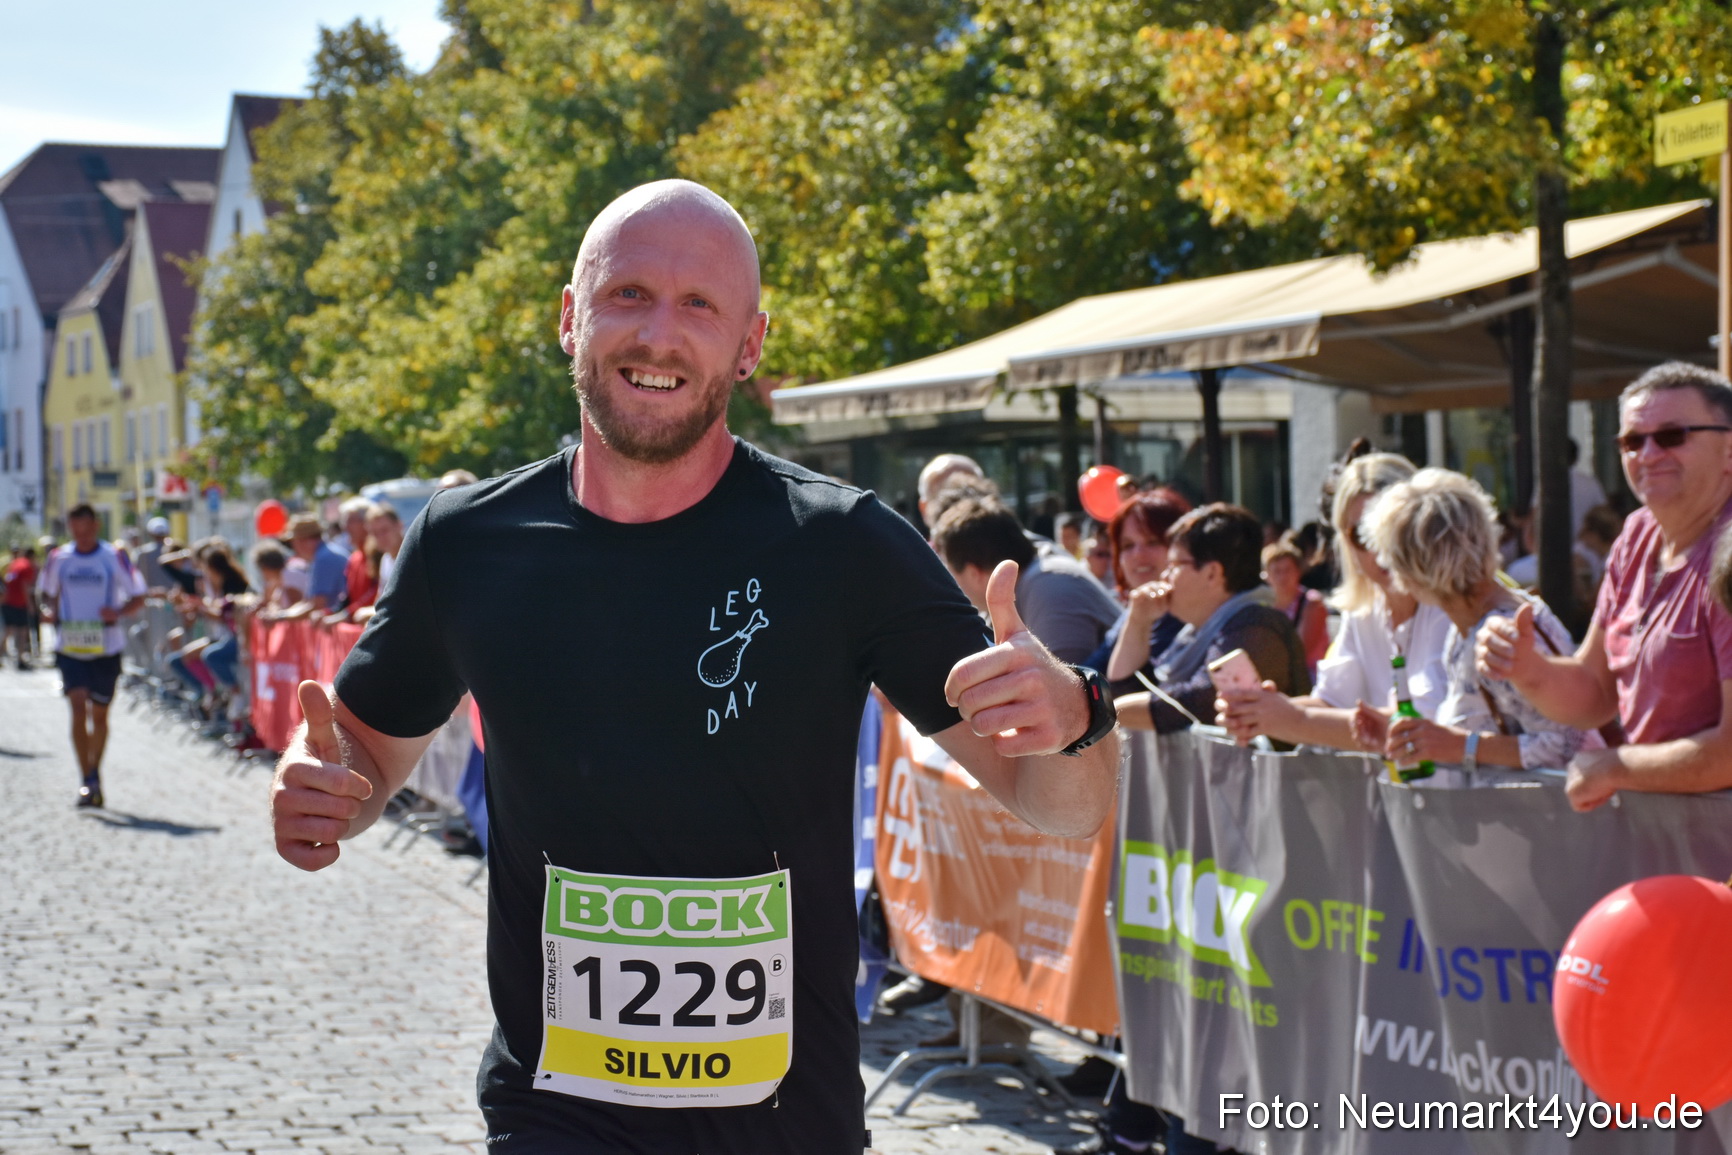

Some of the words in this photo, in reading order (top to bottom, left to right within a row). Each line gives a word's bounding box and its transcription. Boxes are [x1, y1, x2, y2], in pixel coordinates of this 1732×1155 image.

[709, 577, 762, 631] LEG
[707, 681, 758, 735] DAY
[563, 881, 773, 937] BOCK
[572, 955, 766, 1028] 1229
[773, 959, 782, 972] B
[604, 1047, 731, 1080] SILVIO
